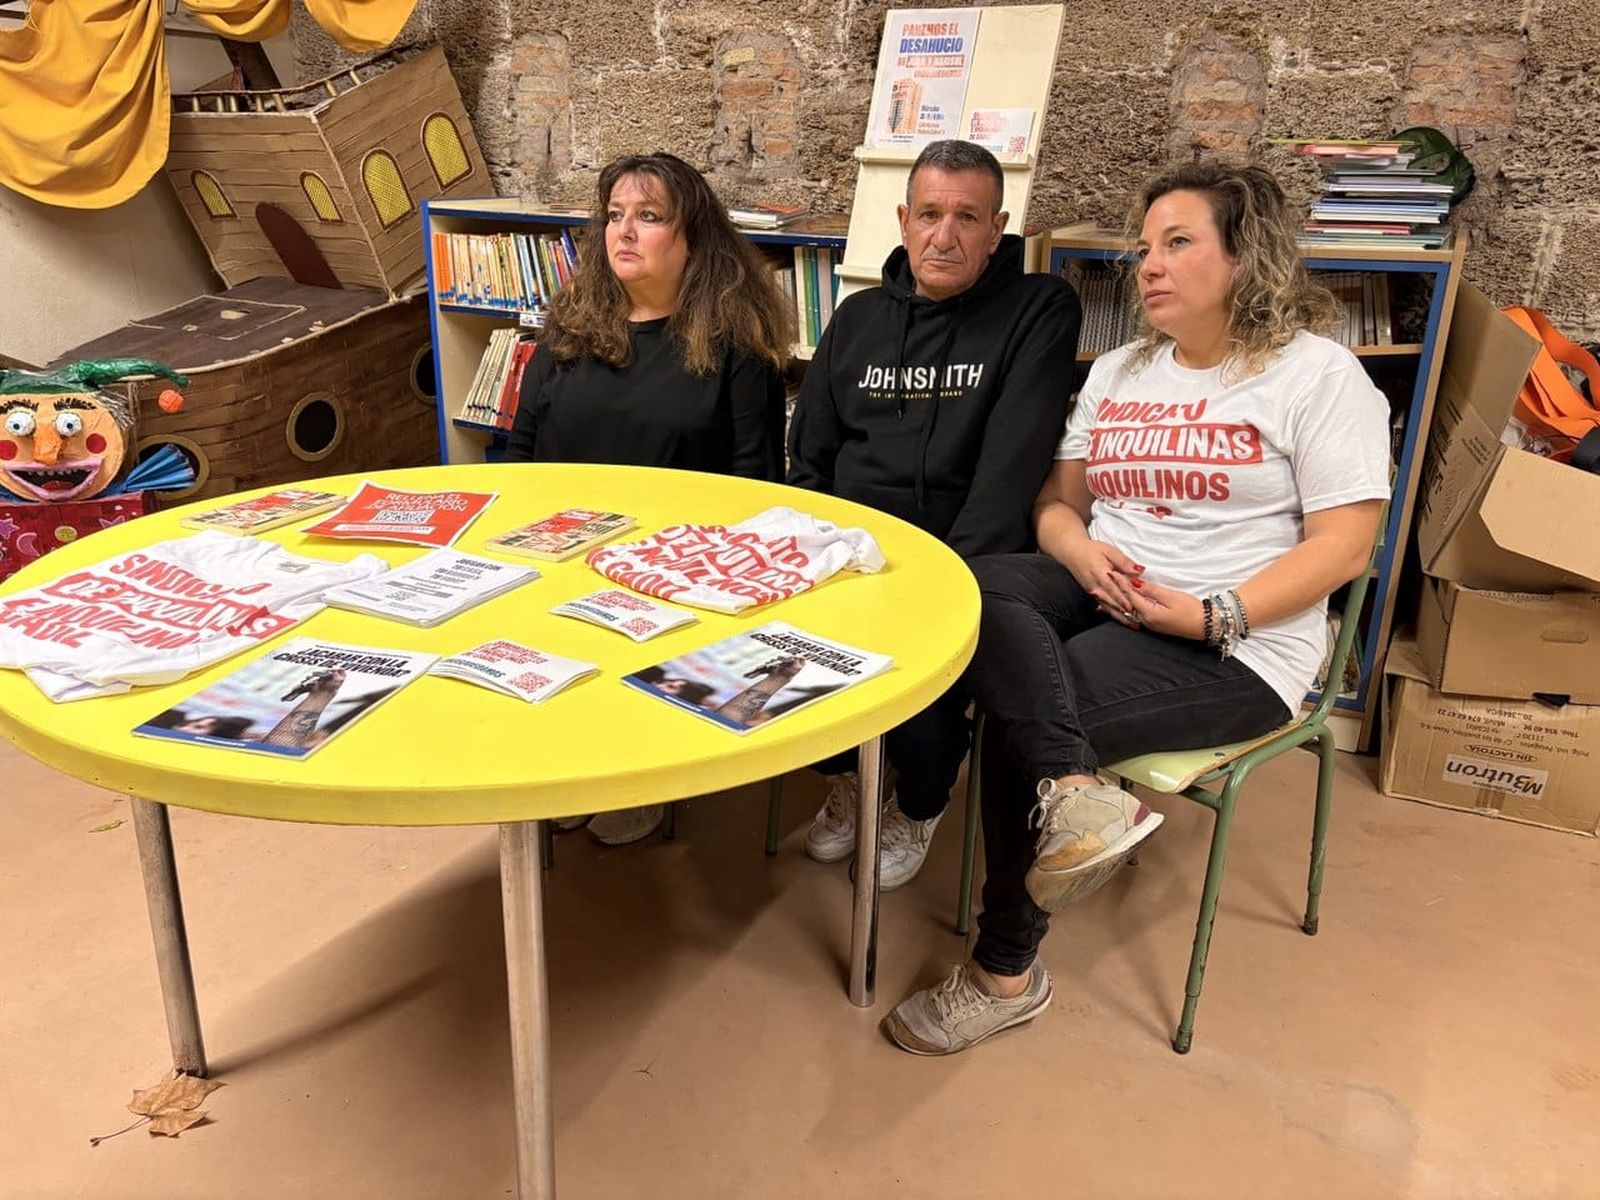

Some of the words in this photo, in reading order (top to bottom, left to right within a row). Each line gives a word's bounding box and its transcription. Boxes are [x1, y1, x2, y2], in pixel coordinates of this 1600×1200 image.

[899, 37, 963, 53] DESAHUCIO
[1096, 427, 1254, 461] INQUILINAS
[273, 652, 321, 666] CRISIS
[1517, 752, 1534, 761] SIN
